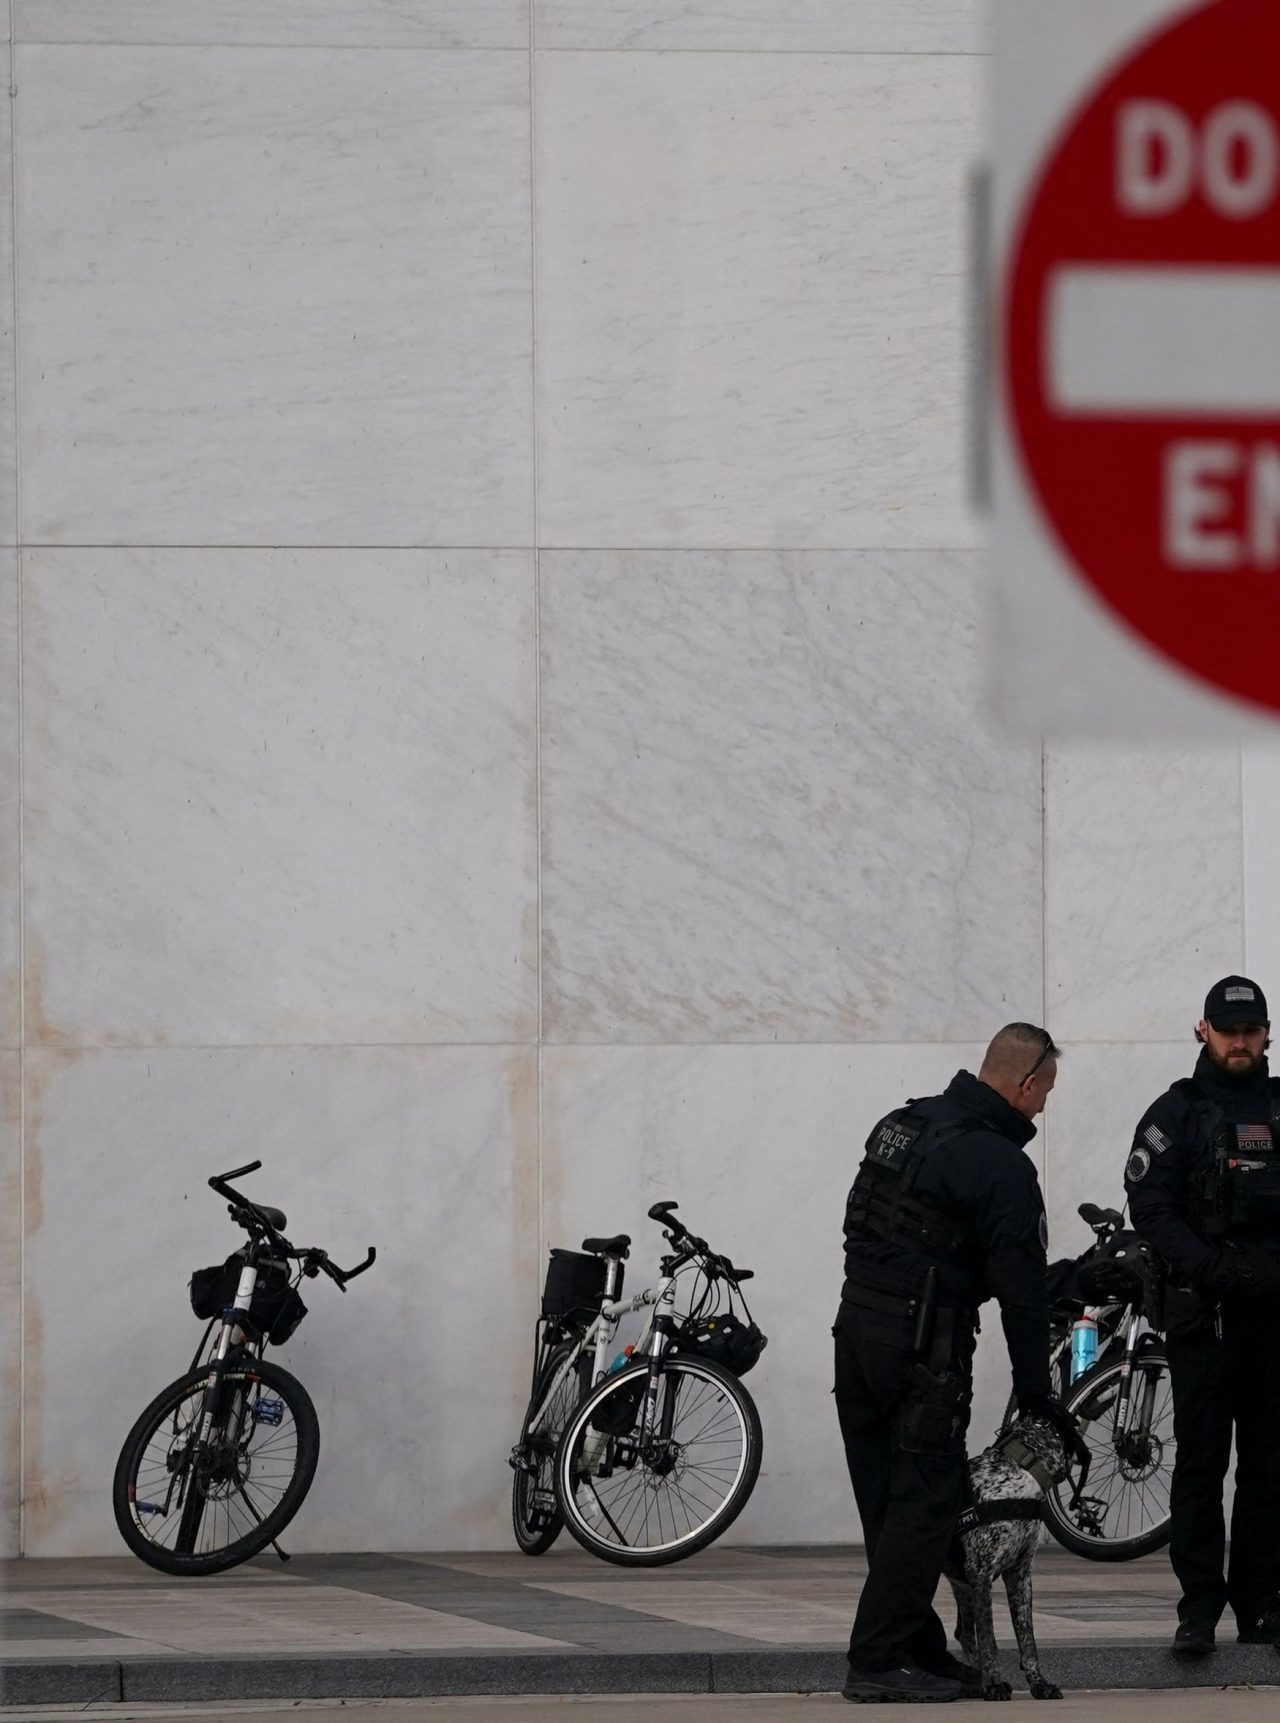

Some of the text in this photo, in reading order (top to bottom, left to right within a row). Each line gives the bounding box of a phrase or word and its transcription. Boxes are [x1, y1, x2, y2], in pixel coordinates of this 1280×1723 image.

[1116, 99, 1280, 218] DO
[879, 1127, 911, 1150] POLICE
[1238, 1140, 1273, 1150] POLICE
[877, 1142, 896, 1159] K-9
